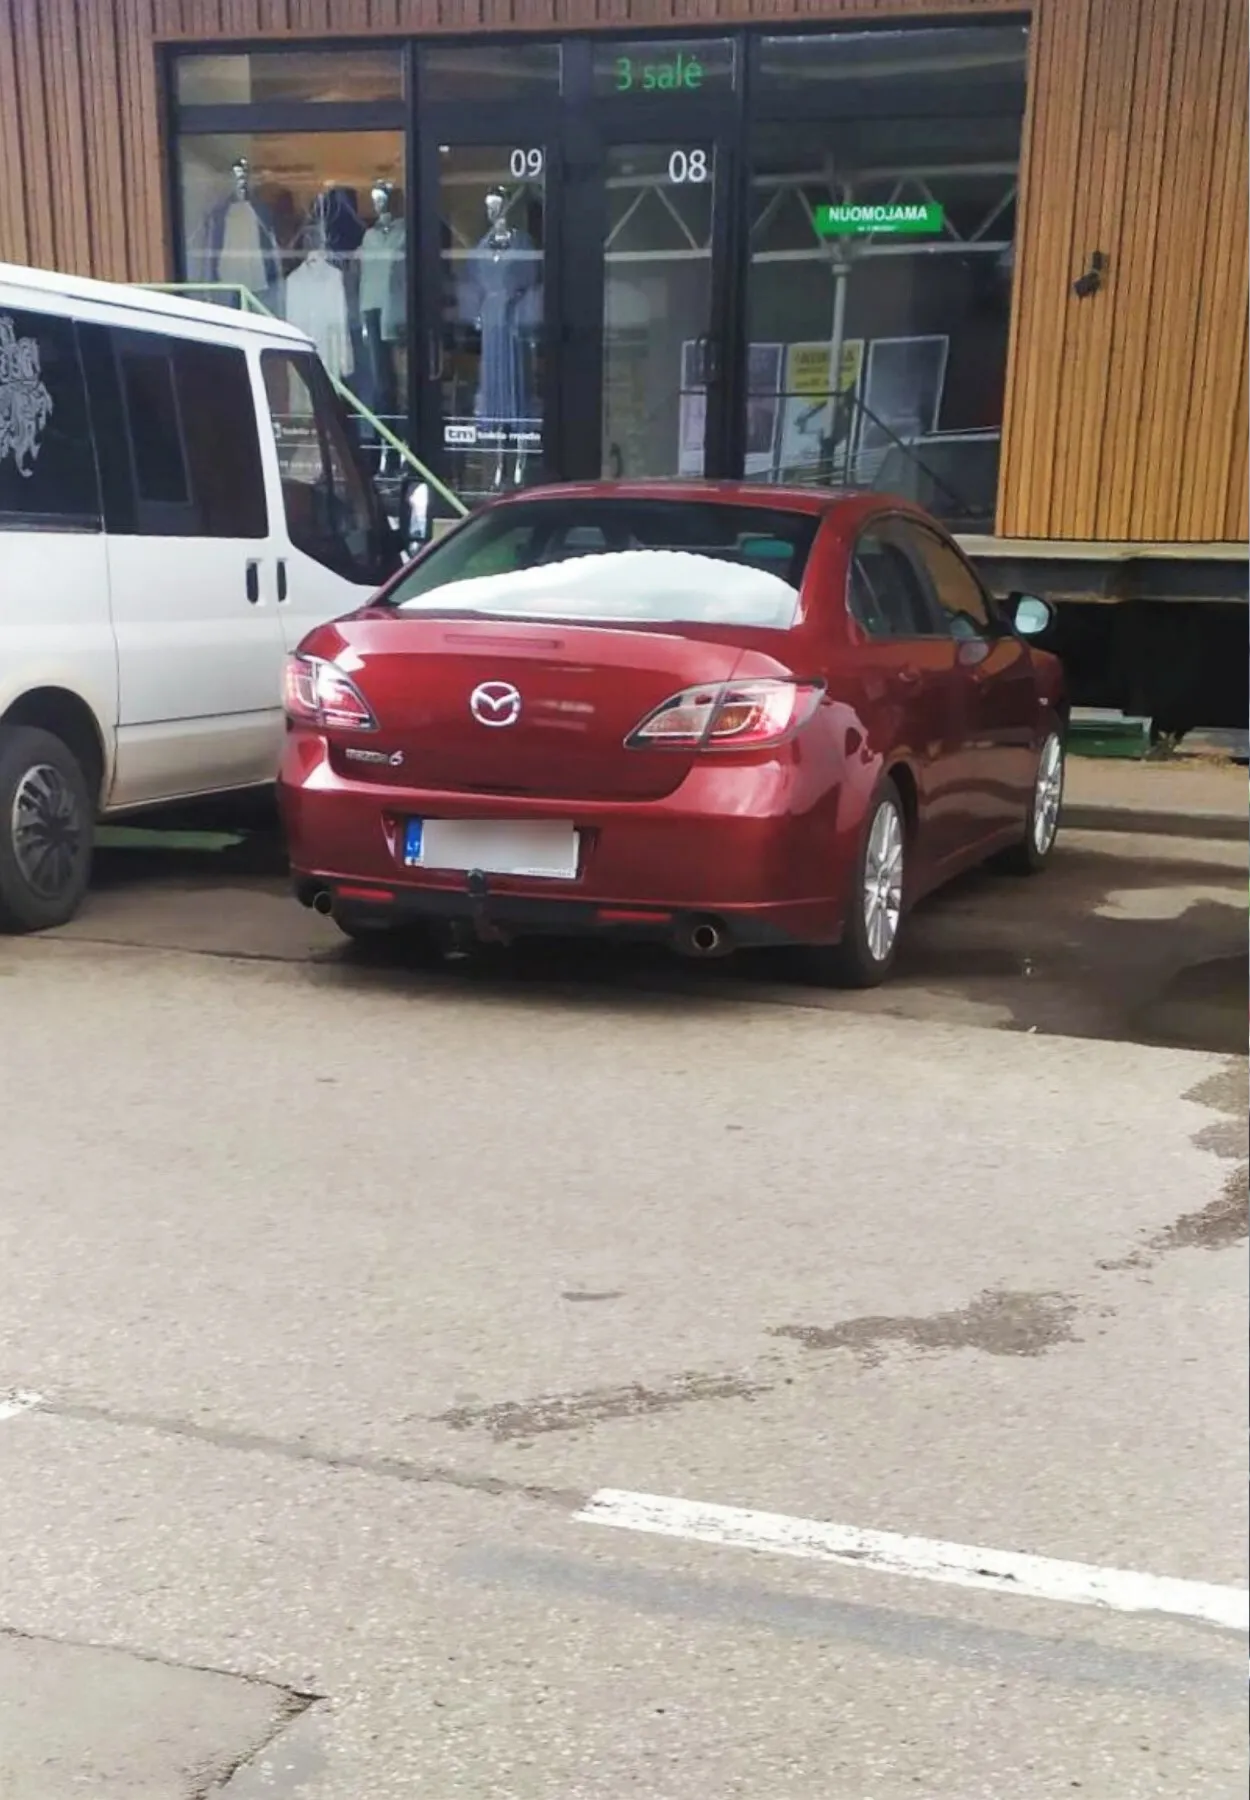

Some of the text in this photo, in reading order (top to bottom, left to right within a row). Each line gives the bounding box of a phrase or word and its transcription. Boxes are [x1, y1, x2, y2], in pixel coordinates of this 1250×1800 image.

[616, 52, 704, 91] 3 salė
[510, 148, 543, 178] 09
[668, 149, 707, 183] 08
[828, 205, 928, 222] NUOMOJAMA
